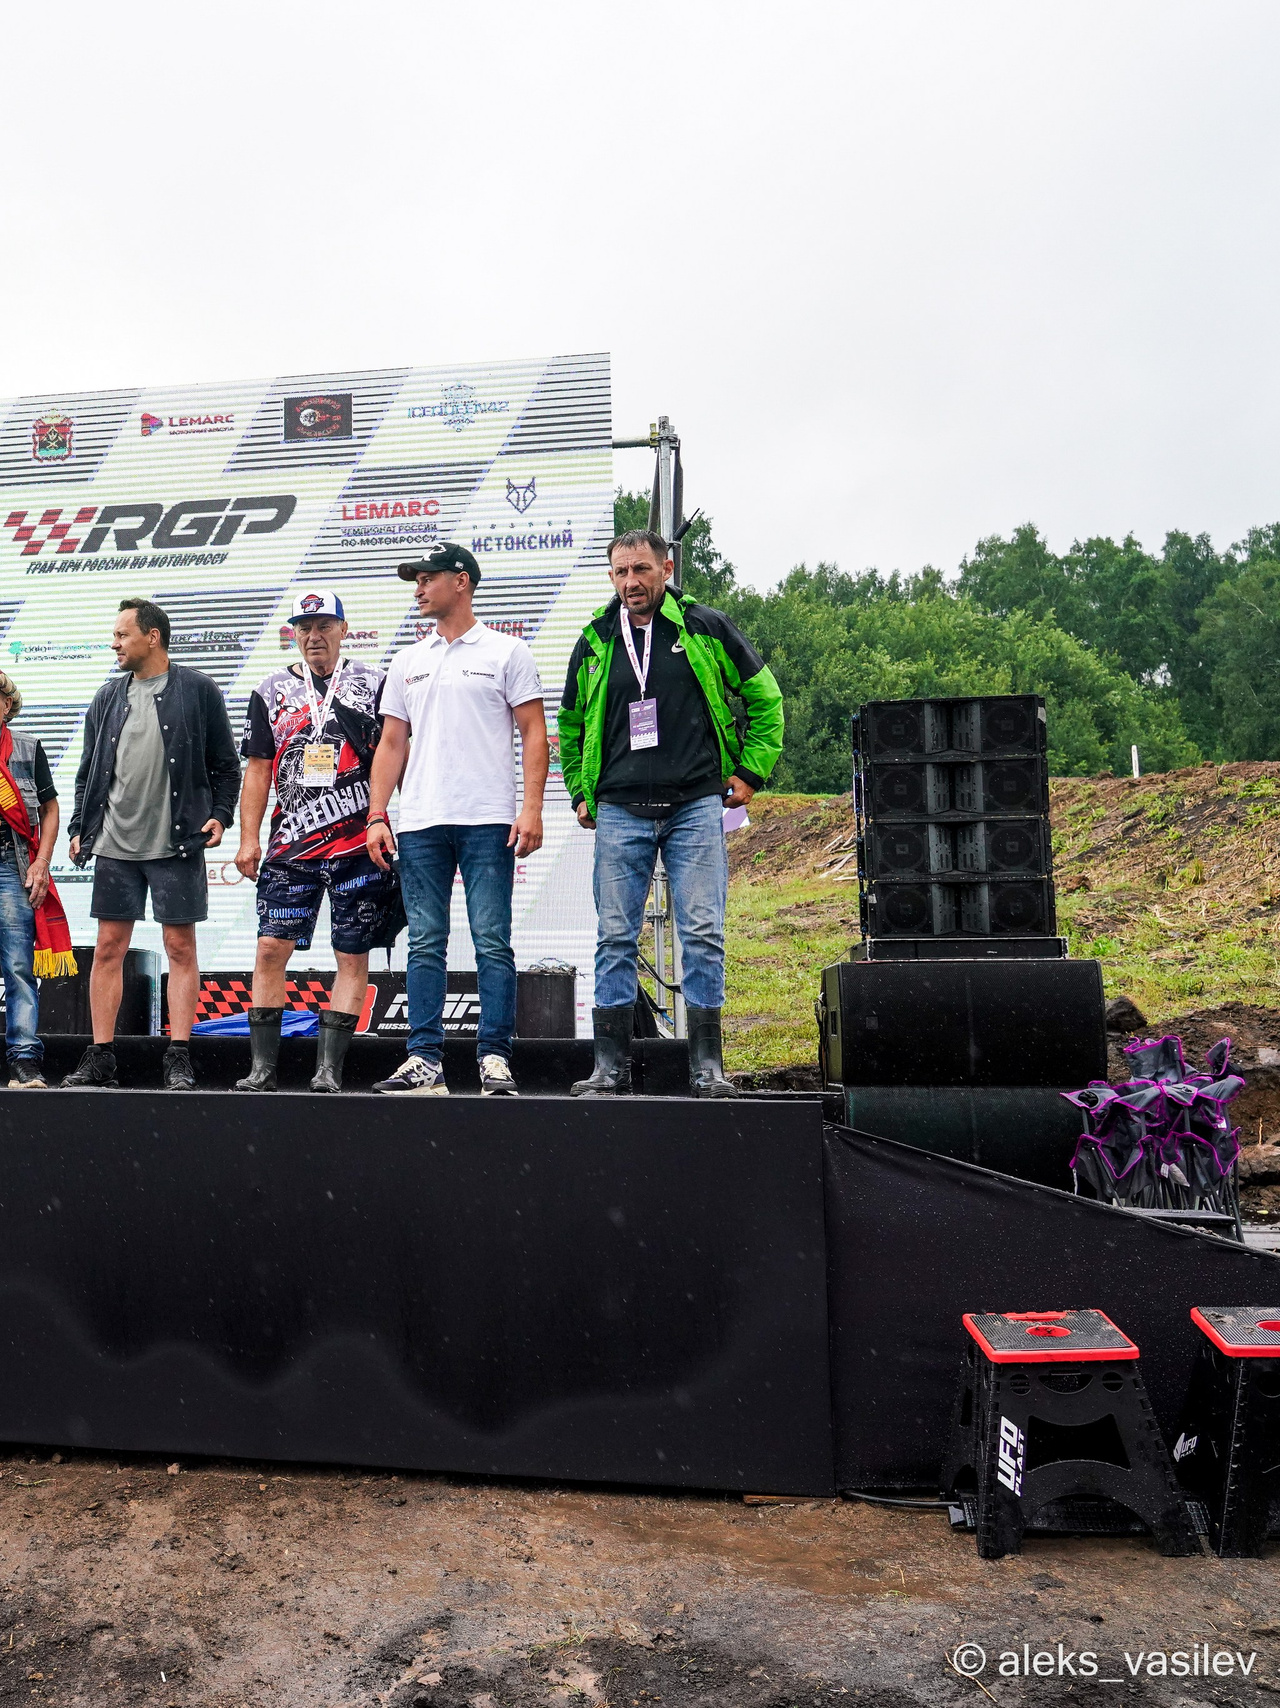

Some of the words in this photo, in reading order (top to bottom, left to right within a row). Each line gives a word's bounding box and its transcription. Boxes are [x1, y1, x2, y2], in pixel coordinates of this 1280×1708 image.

[168, 413, 234, 427] LEMARC
[342, 500, 440, 521] LEMARC
[79, 494, 297, 553] RGP
[341, 525, 396, 536] ЧЕМПИОНАТ
[399, 523, 438, 533] РОССИИ
[341, 538, 357, 547] ПО
[360, 534, 438, 546] МОТОКРОССУ
[472, 530, 574, 553] ИСТОКСКИЙ
[26, 558, 81, 574] ГРАН-ПРИ
[82, 555, 131, 571] РОССИИ
[150, 552, 229, 568] МОТОКРОССУ
[997, 1415, 1018, 1491] UFO
[1181, 1436, 1198, 1453] UFO
[1015, 1428, 1025, 1497] PLAST
